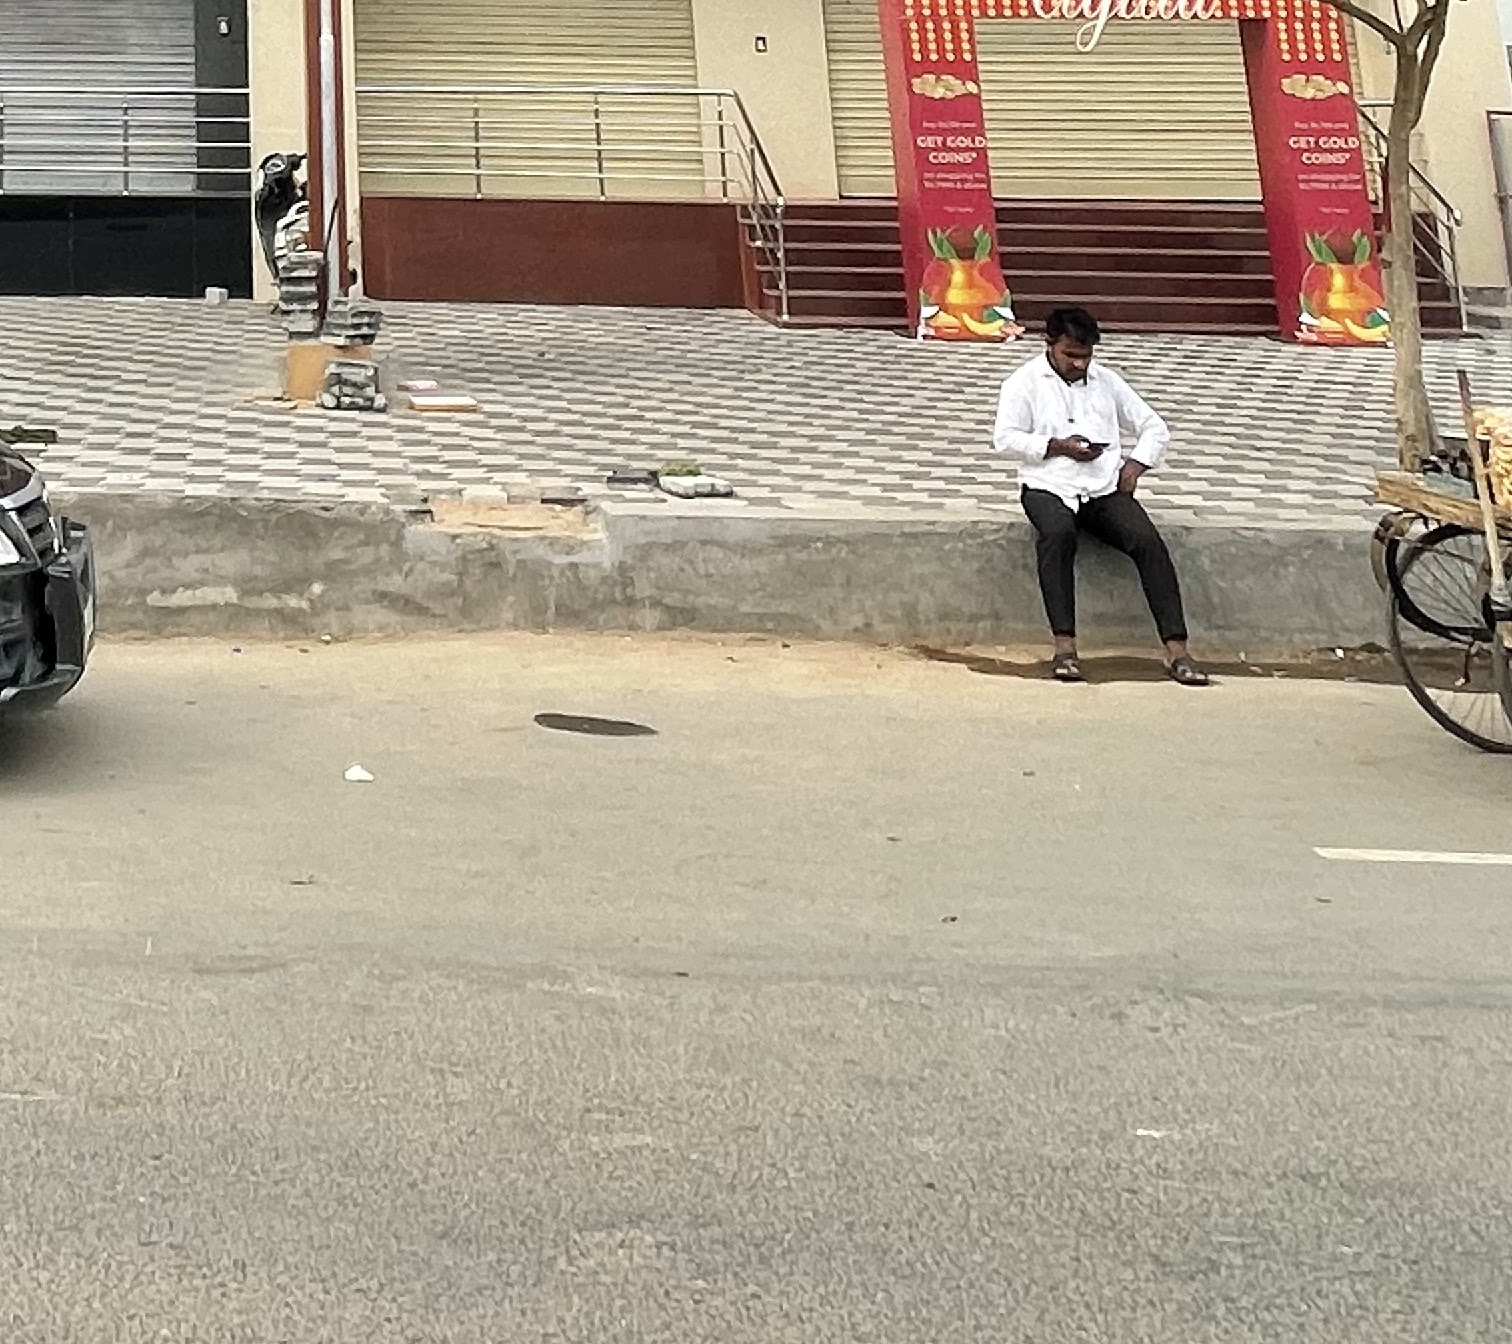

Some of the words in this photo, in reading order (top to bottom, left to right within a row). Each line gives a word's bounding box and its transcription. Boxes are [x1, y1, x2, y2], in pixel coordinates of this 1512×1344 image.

[916, 136, 944, 148] GET
[946, 136, 986, 148] GOLD
[1288, 136, 1316, 149] GET
[1318, 136, 1360, 149] GOLD
